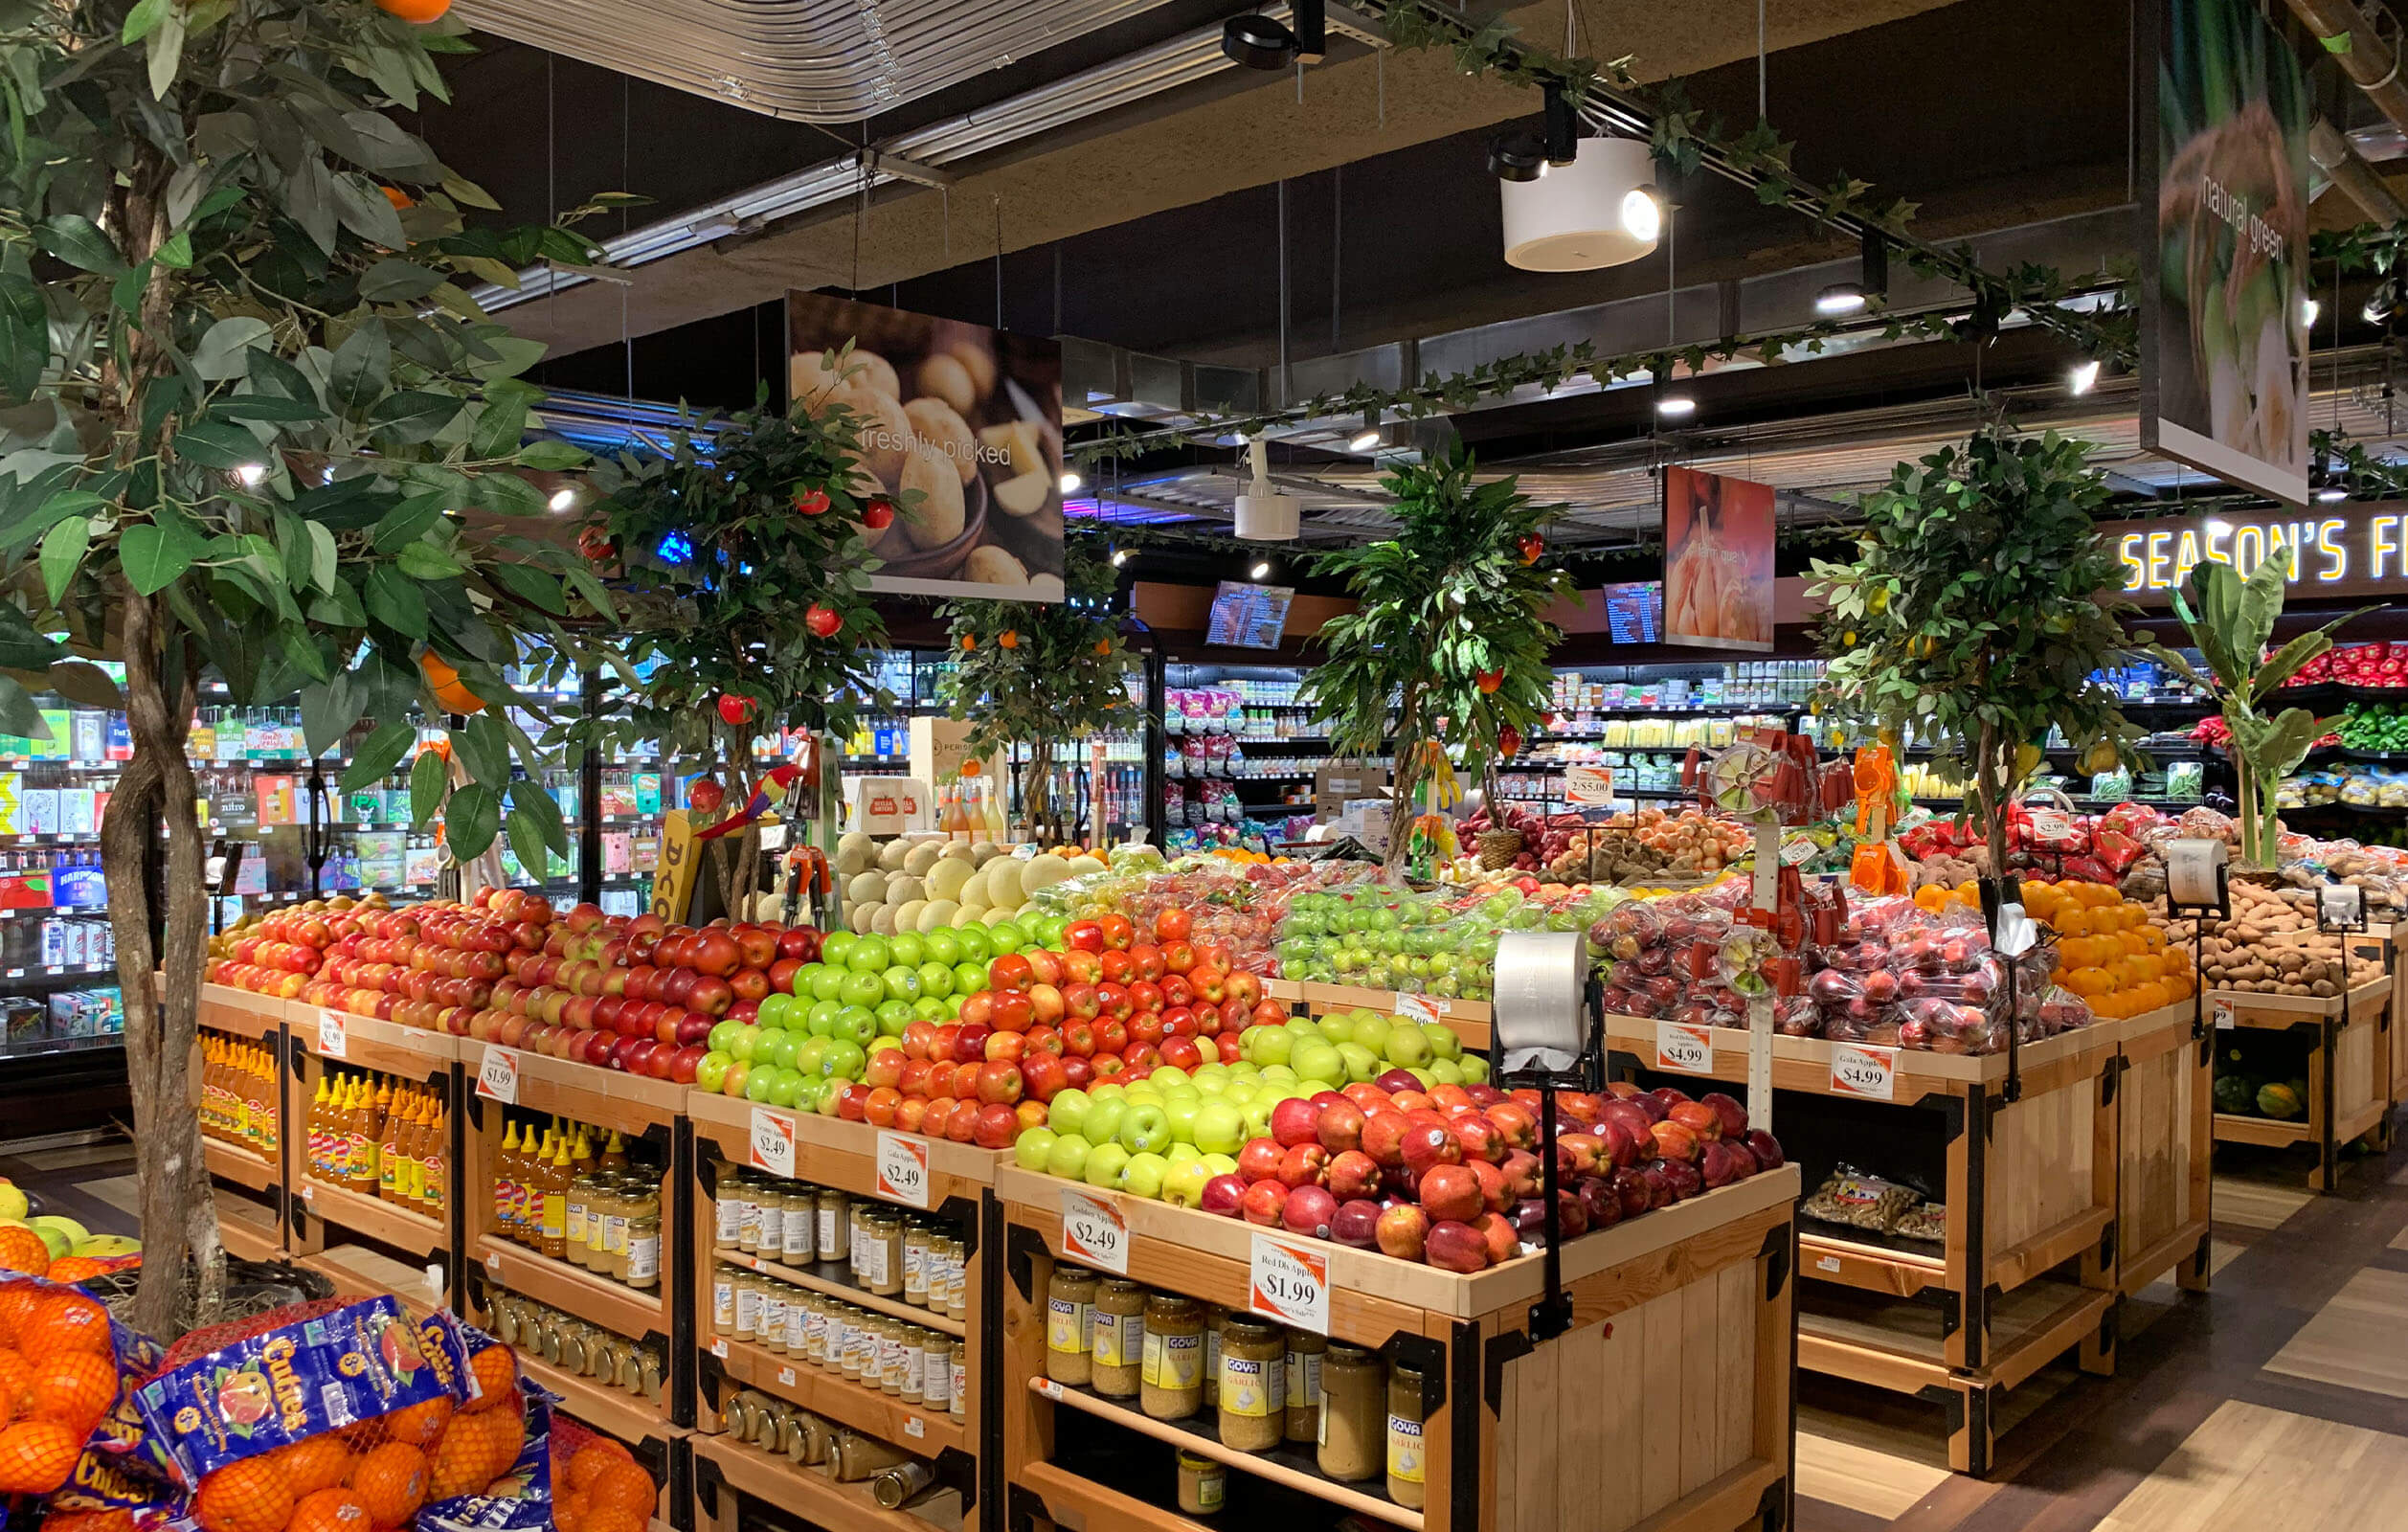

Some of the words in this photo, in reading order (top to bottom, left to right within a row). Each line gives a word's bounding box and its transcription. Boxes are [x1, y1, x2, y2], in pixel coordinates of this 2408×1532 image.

[2201, 174, 2249, 237] natural
[2250, 214, 2284, 264] green
[943, 439, 1012, 466] picked
[2119, 517, 2346, 591] SEASON'S
[2372, 514, 2408, 579] F
[221, 801, 246, 813] nitro
[350, 795, 380, 808] IPA
[1668, 1047, 1702, 1062] $4.99
[485, 1067, 511, 1085] $1.99
[1843, 1068, 1882, 1085] $4.99
[760, 1135, 785, 1156] $2.49
[887, 1163, 919, 1187] $2.49
[1075, 1221, 1116, 1250] $2.49
[1261, 1254, 1276, 1267] Red
[1291, 1264, 1318, 1278] Apples
[1267, 1273, 1316, 1305] $1.99
[1095, 1313, 1114, 1326] OYA
[1170, 1337, 1199, 1348] GOYA
[1228, 1359, 1259, 1373] GOYA
[262, 1338, 308, 1432] Cuties
[1227, 1377, 1261, 1387] GARLIC
[1391, 1418, 1422, 1436] GOYA
